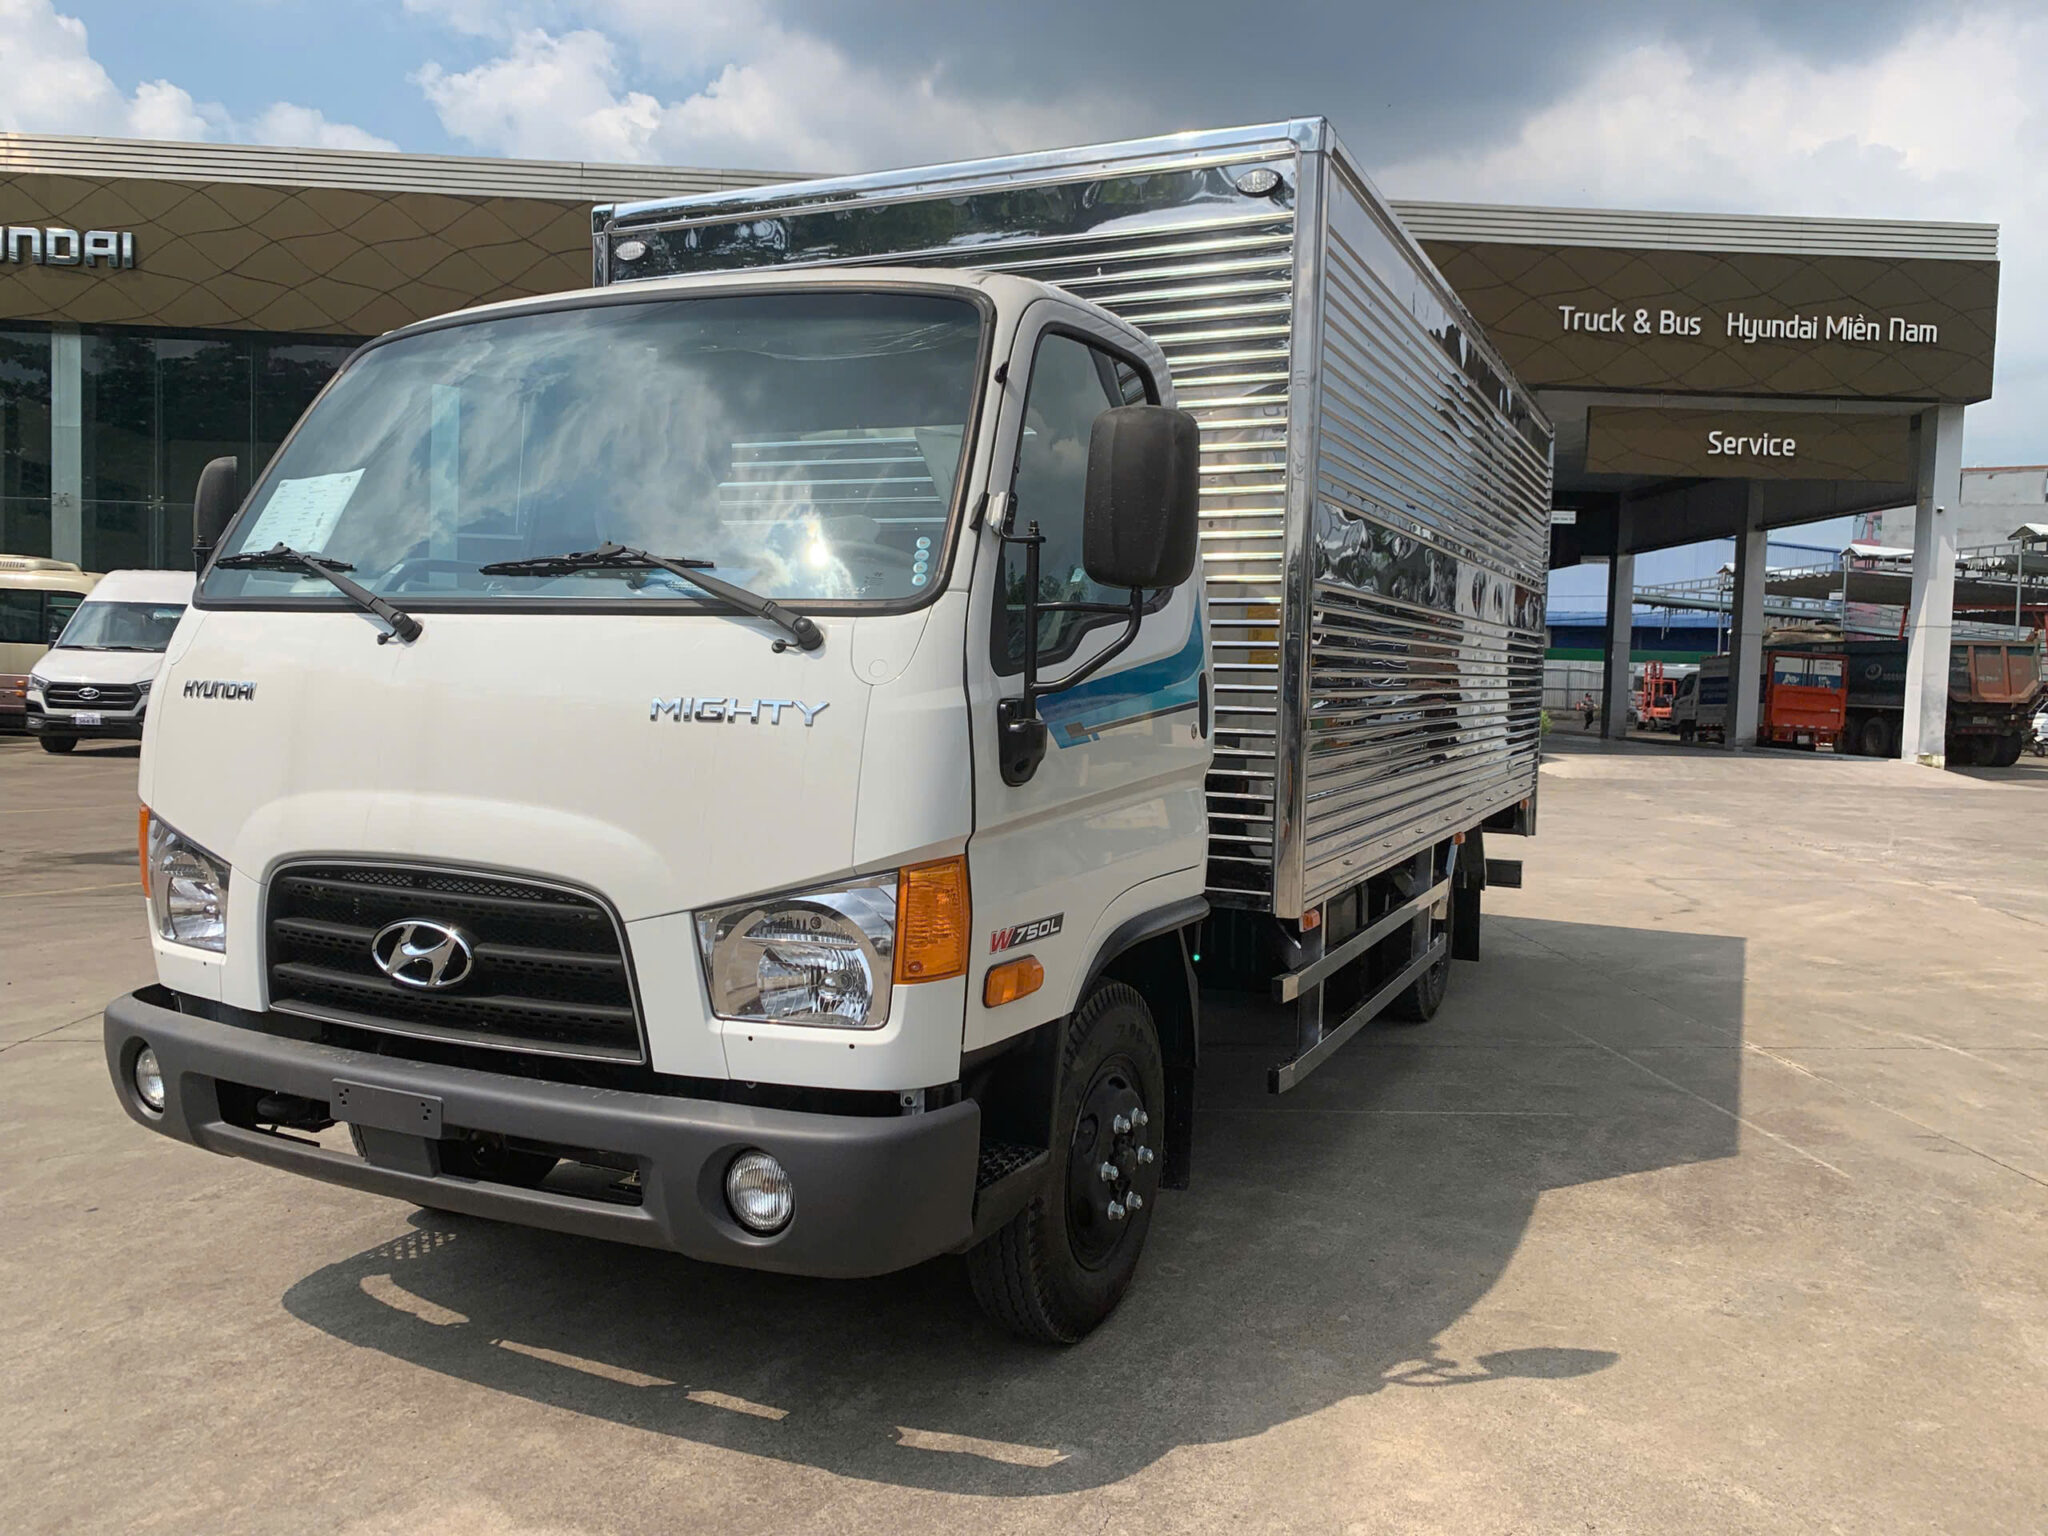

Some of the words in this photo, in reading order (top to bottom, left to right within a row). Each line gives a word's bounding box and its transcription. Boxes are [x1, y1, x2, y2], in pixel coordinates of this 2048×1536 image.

[0, 226, 134, 269] NDAI
[1558, 305, 1626, 333] Truck
[1633, 308, 1652, 335] &
[1659, 310, 1702, 336] Bus
[1727, 312, 1819, 343] Hyundai
[1825, 313, 1880, 342] Miền
[1889, 317, 1938, 343] Nam
[1707, 430, 1796, 457] Service
[183, 680, 257, 701] HYUNDAI
[650, 697, 830, 727] MIGHTY
[990, 918, 1061, 954] W750L
